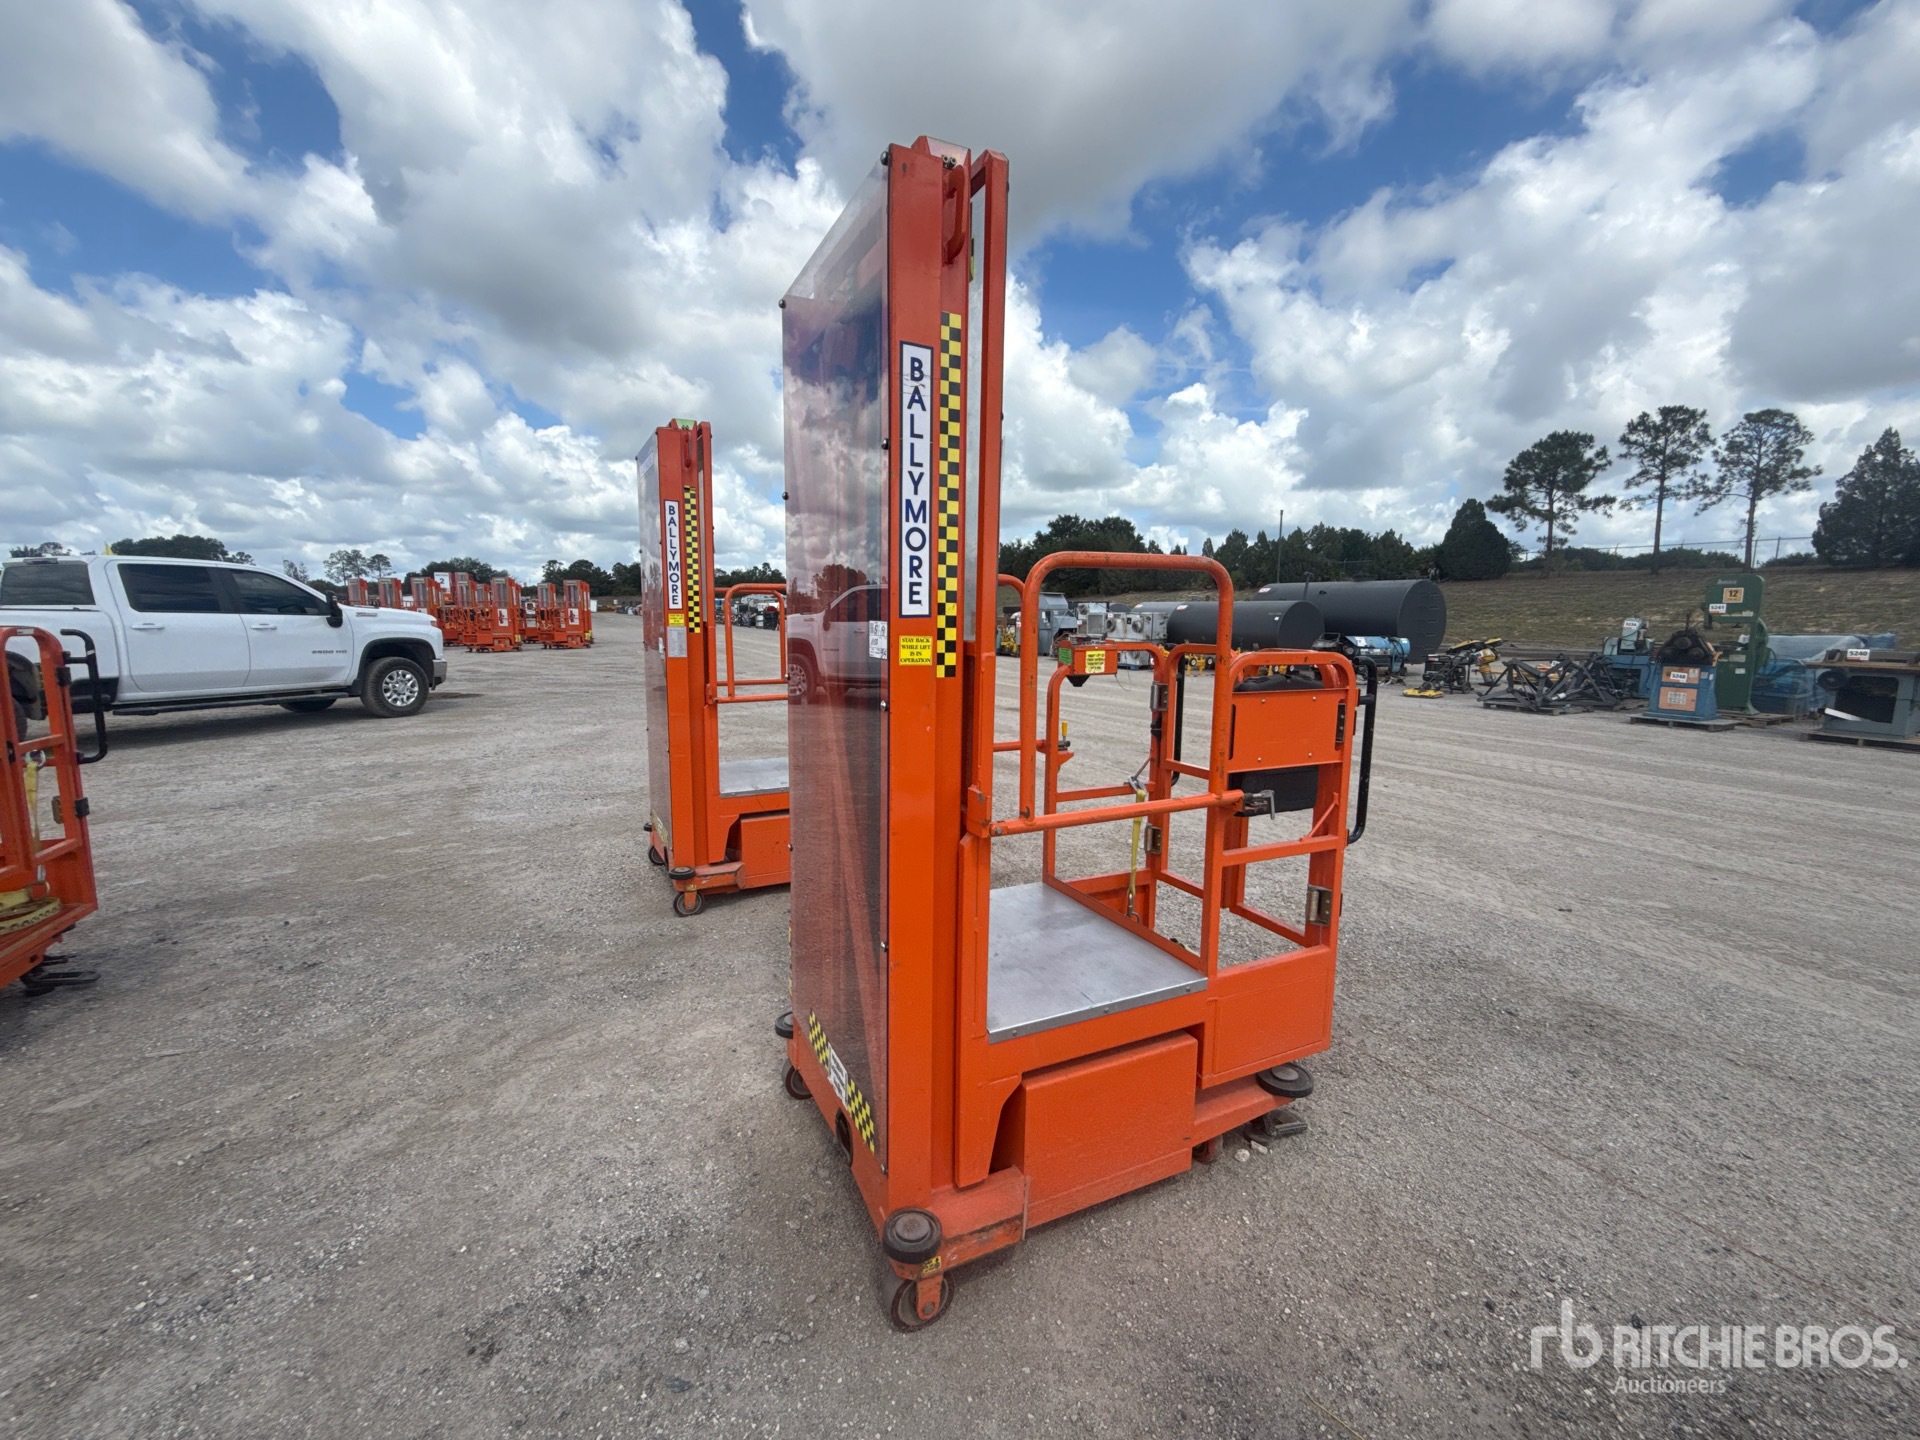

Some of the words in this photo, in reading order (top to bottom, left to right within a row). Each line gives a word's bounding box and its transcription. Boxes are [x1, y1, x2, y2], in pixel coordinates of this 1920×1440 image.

[905, 356, 927, 606] BALLYMORE
[668, 504, 680, 605] BALLYMORE
[1728, 589, 1739, 598] 12
